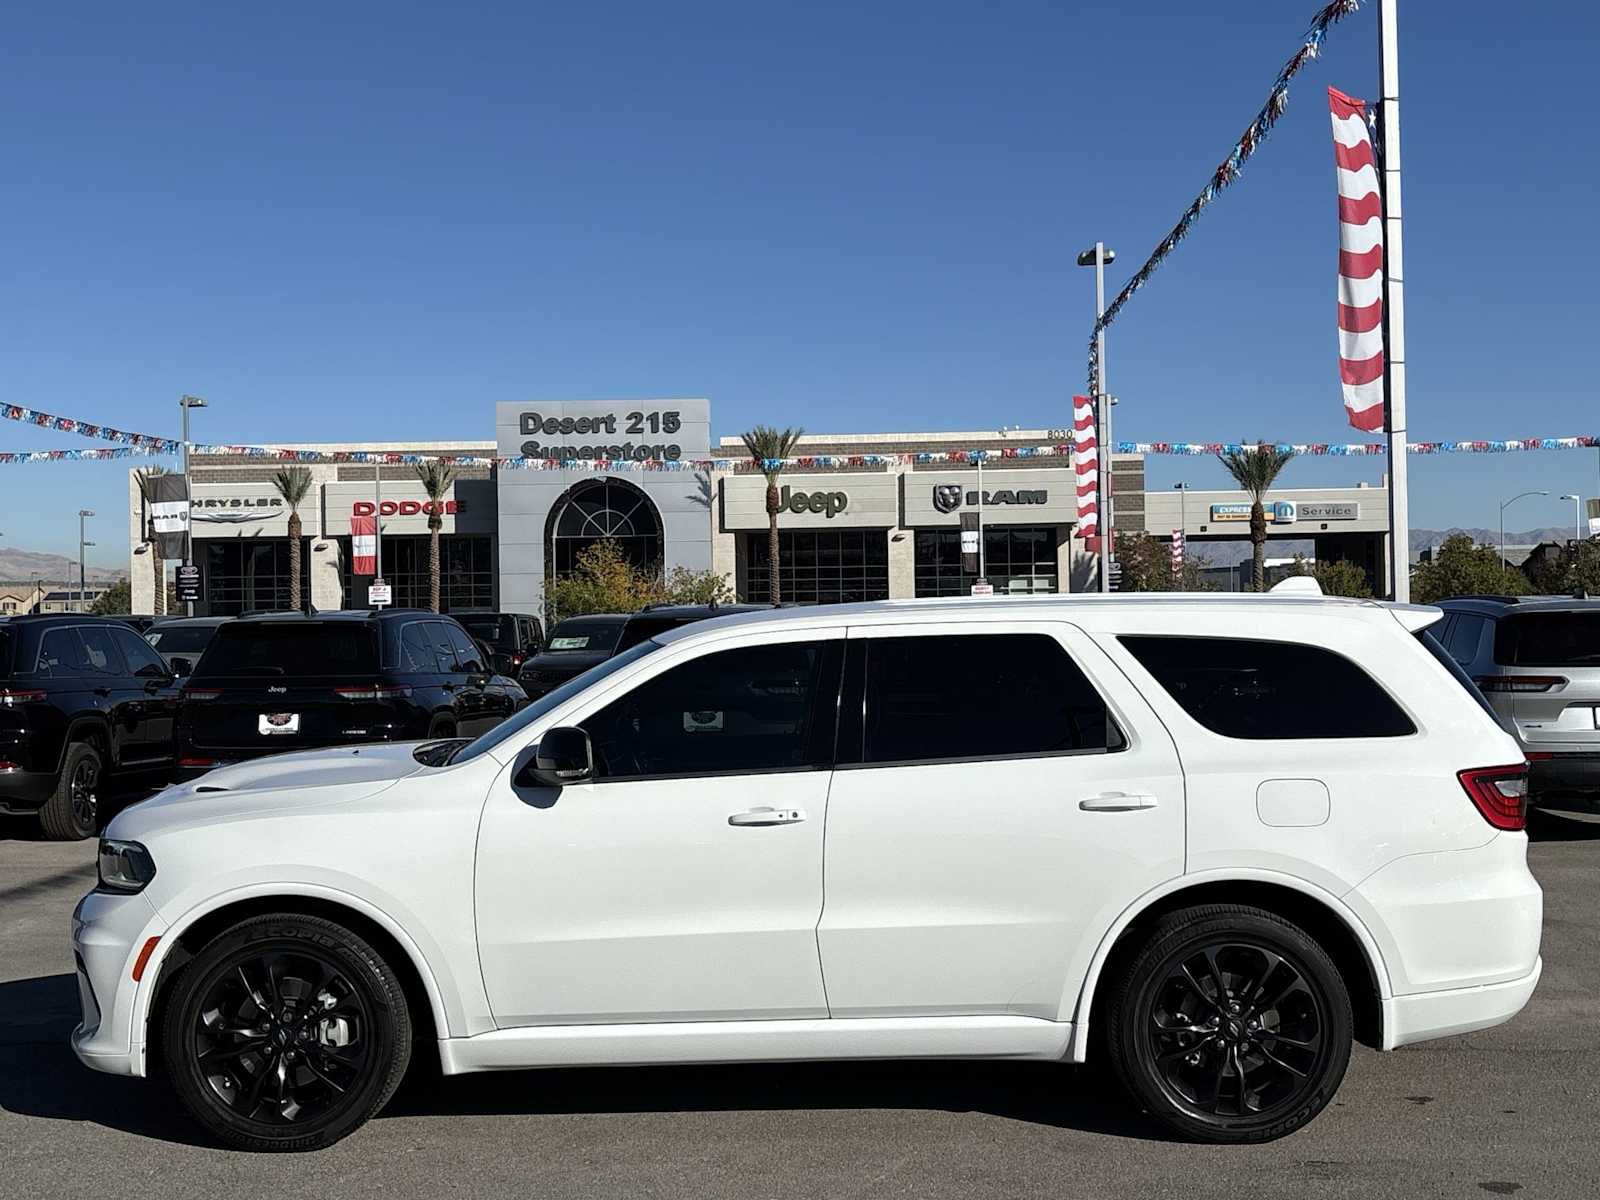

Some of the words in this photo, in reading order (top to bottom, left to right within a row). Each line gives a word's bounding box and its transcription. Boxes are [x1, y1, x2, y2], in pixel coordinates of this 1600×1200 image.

[520, 412, 617, 435] Desert
[625, 411, 681, 434] 215
[1047, 430, 1073, 439] 8030
[520, 440, 682, 461] Superstore
[191, 498, 283, 507] HRYSLER
[777, 485, 848, 518] Jeep
[966, 490, 1048, 505] RAM
[1301, 506, 1352, 516] Service
